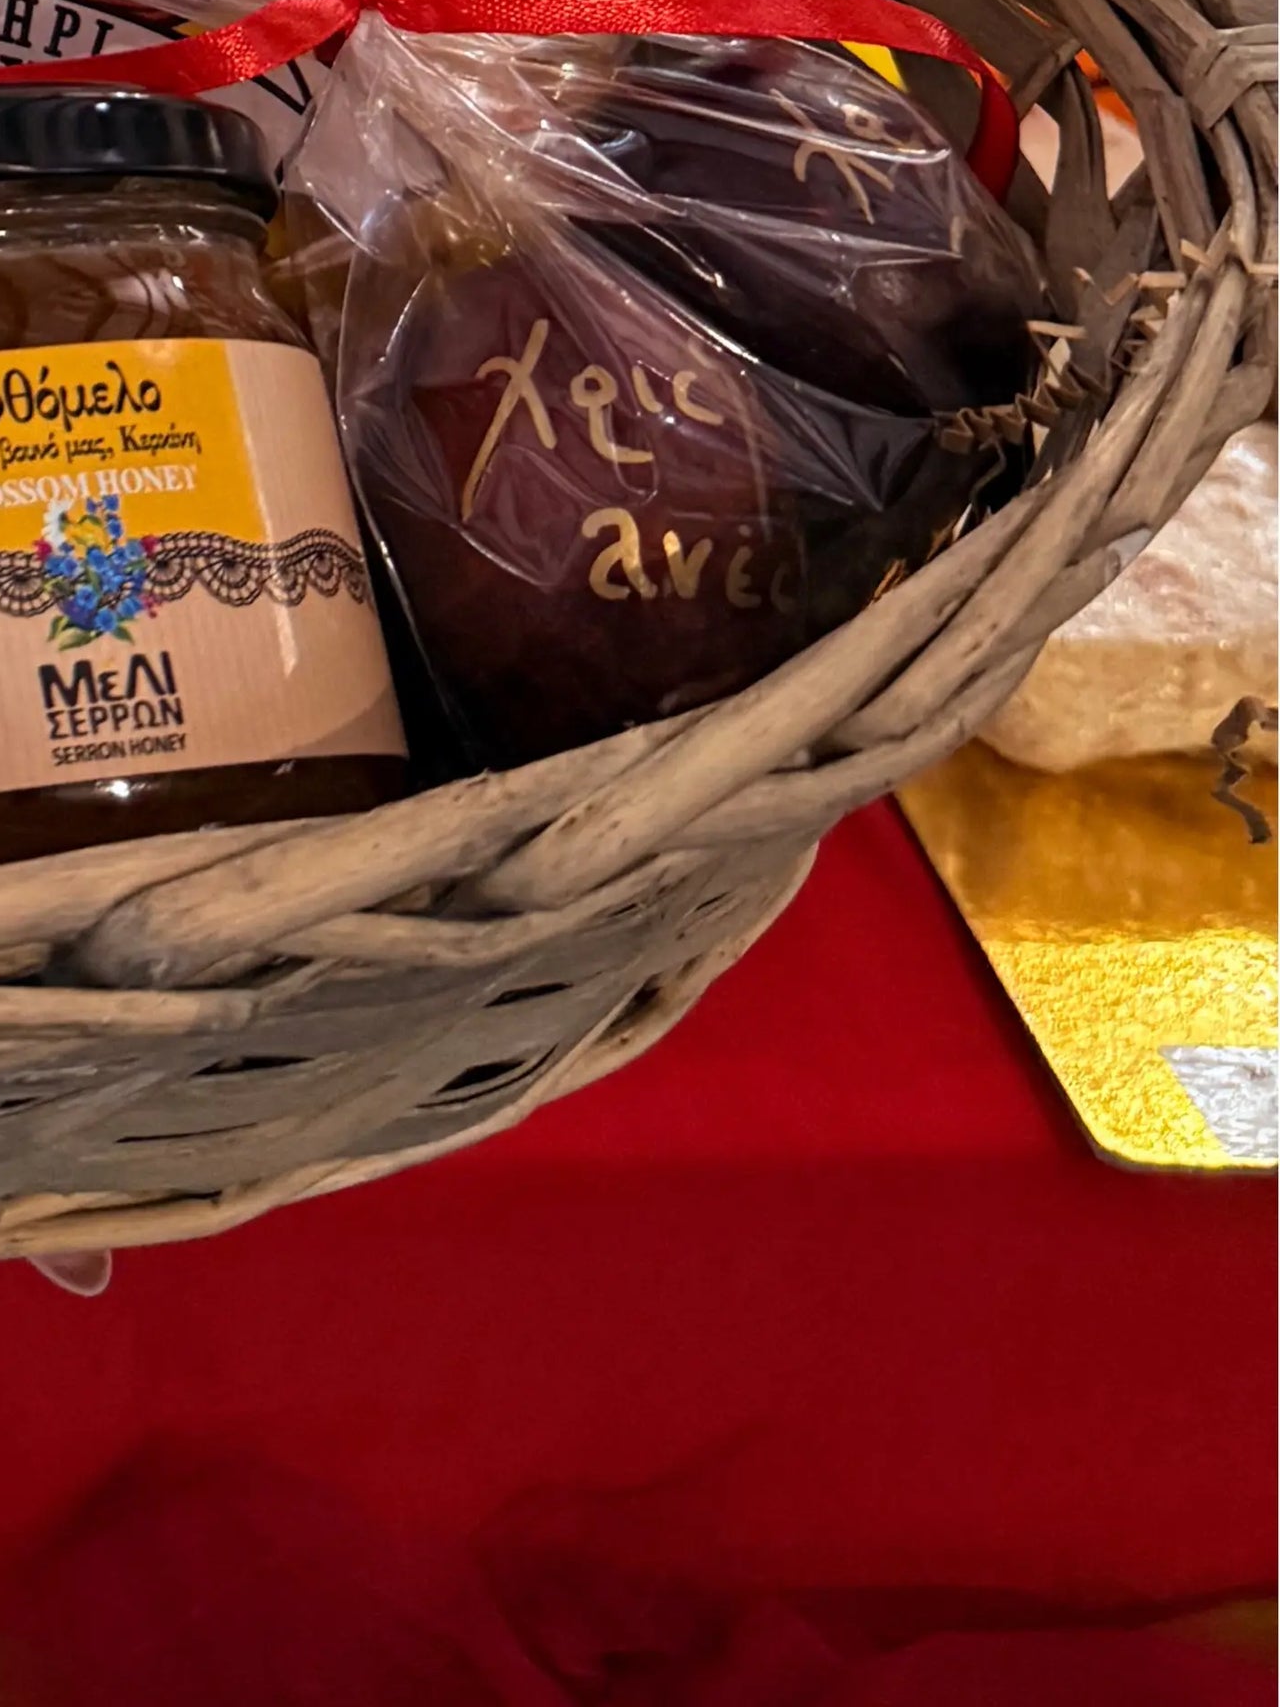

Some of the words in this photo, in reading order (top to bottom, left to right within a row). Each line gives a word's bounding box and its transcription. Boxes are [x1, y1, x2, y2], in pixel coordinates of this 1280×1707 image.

[94, 464, 197, 497] HONEY
[46, 697, 184, 740] ΣΕΡΡΩΝ
[51, 741, 127, 767] SERRON
[128, 733, 187, 756] HONEY
